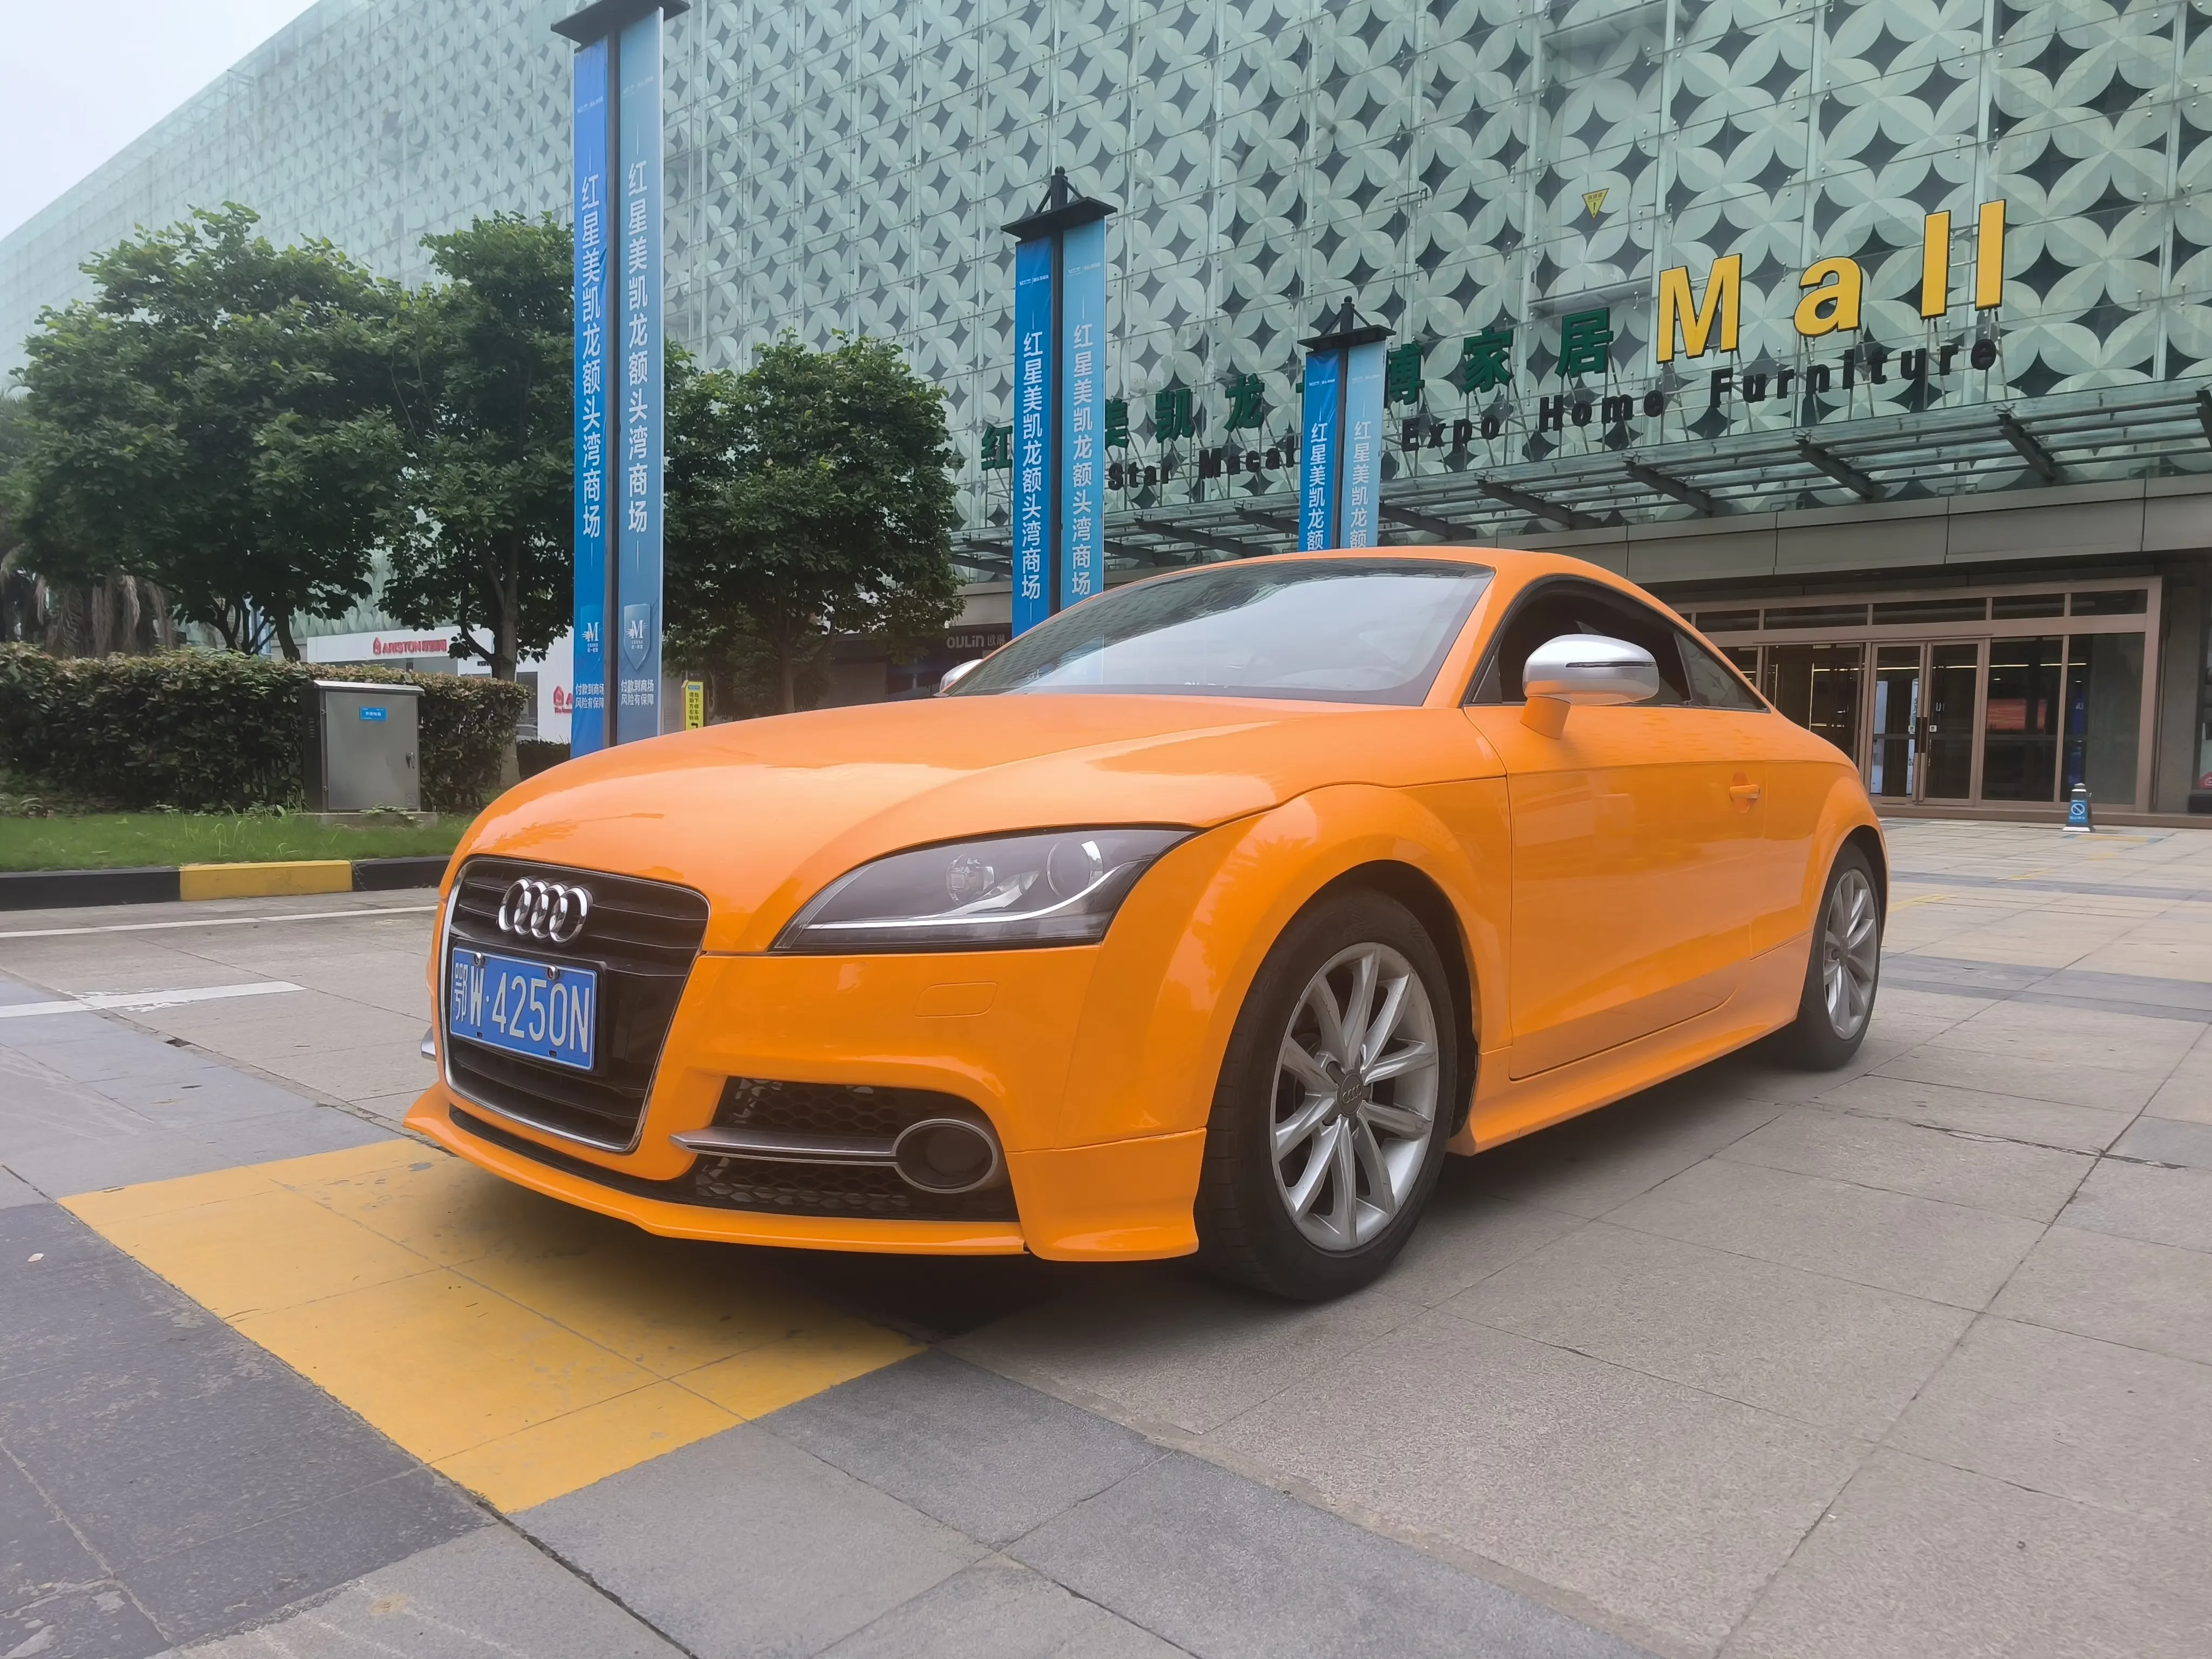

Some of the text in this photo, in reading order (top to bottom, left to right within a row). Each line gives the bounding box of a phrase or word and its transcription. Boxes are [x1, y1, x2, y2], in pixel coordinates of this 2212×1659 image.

[582, 173, 601, 538] 红星美凯龙额头湾商场
[628, 159, 648, 534] 红星美凯龙额头湾商场
[1656, 199, 2006, 364] Mall
[1022, 331, 1043, 600] 红星美凯龙额头湾商场
[1072, 323, 1093, 596] 红星美凯龙额头湾商场
[1108, 462, 1172, 490] Star
[1402, 415, 1500, 453] Expo
[1539, 390, 1665, 433] Home
[1710, 339, 1997, 408] Furniture
[1307, 422, 1327, 551] 红星美凯龙额
[575, 683, 604, 695] 付款到商场
[621, 679, 654, 692] 付款到商场
[621, 693, 654, 706] 风险有保障
